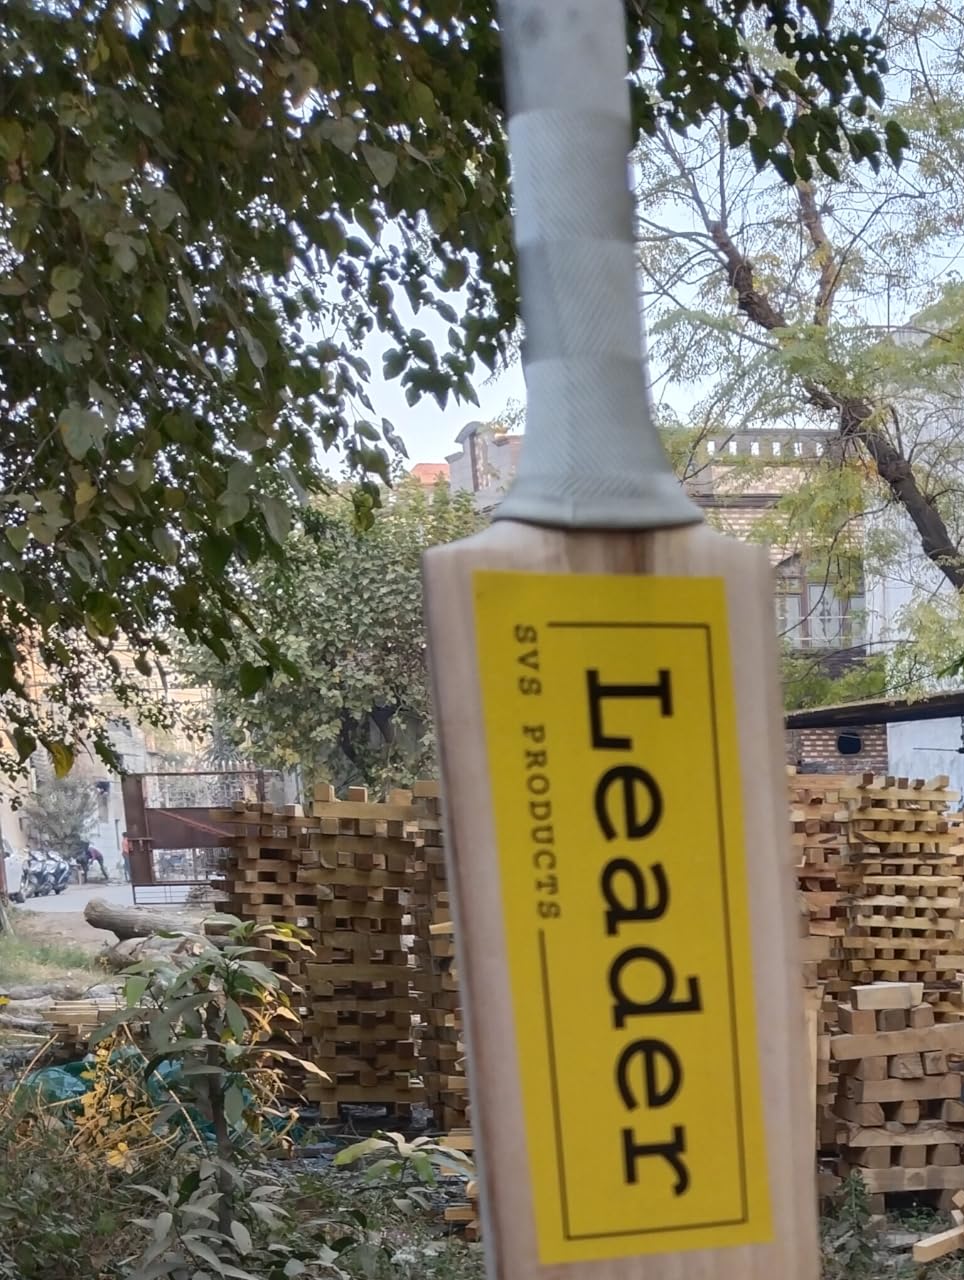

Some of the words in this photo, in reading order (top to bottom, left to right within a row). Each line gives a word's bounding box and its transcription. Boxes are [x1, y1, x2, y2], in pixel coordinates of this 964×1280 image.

[513, 623, 542, 697] SVS
[523, 724, 561, 922] PRODUCTS
[585, 668, 704, 1197] Leader
